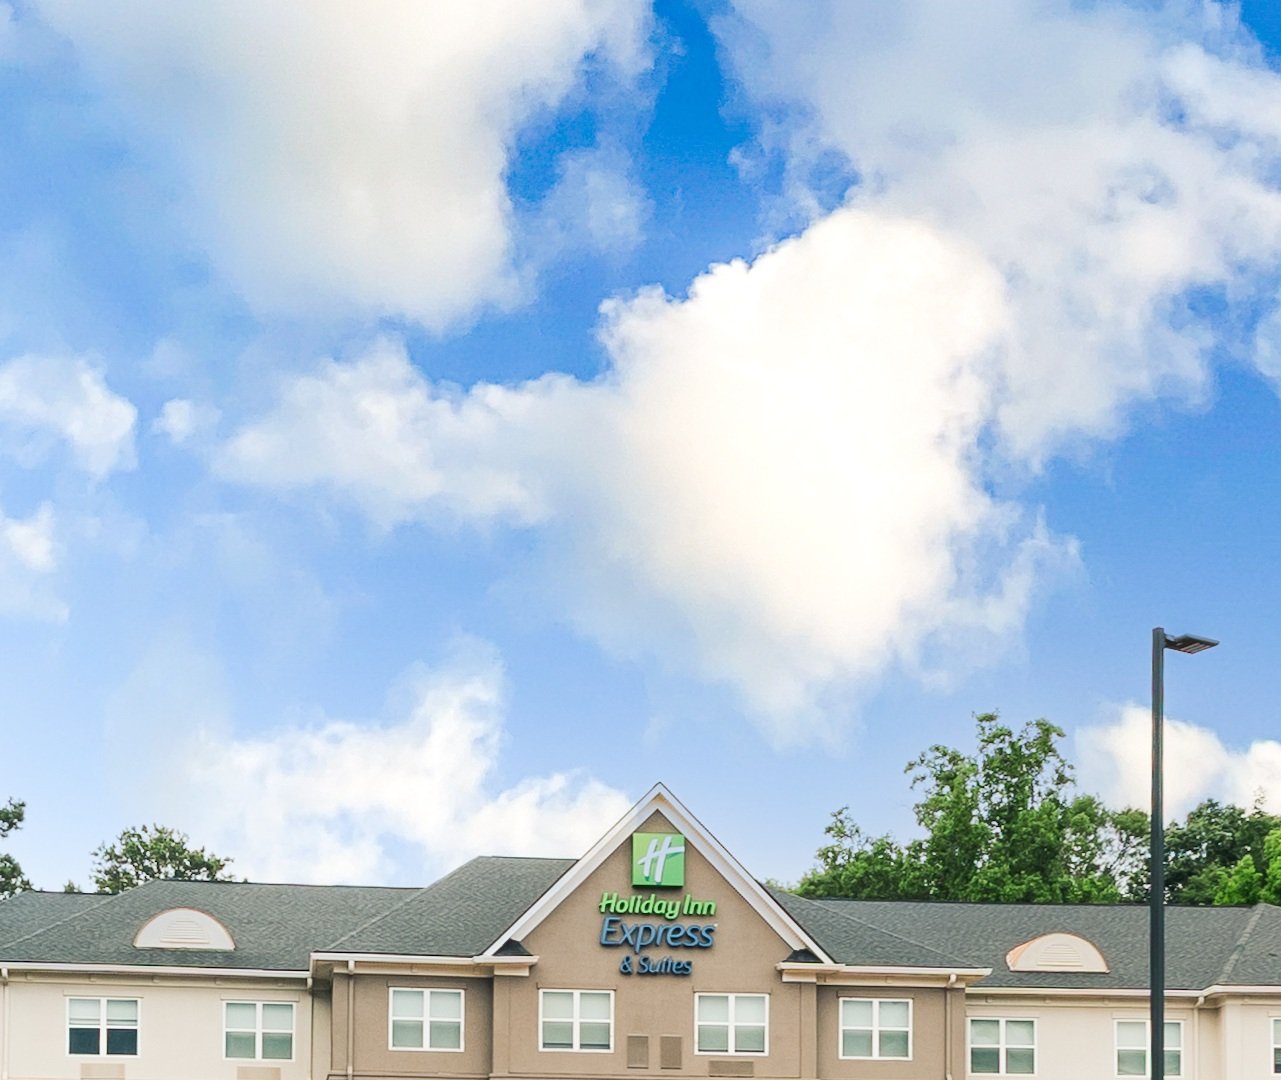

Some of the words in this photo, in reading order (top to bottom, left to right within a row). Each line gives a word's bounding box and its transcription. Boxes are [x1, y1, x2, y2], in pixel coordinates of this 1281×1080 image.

[599, 892, 681, 920] Holiday
[683, 895, 716, 916] Inn
[600, 916, 716, 954] Express
[620, 956, 633, 975] &
[637, 956, 693, 975] Suites
